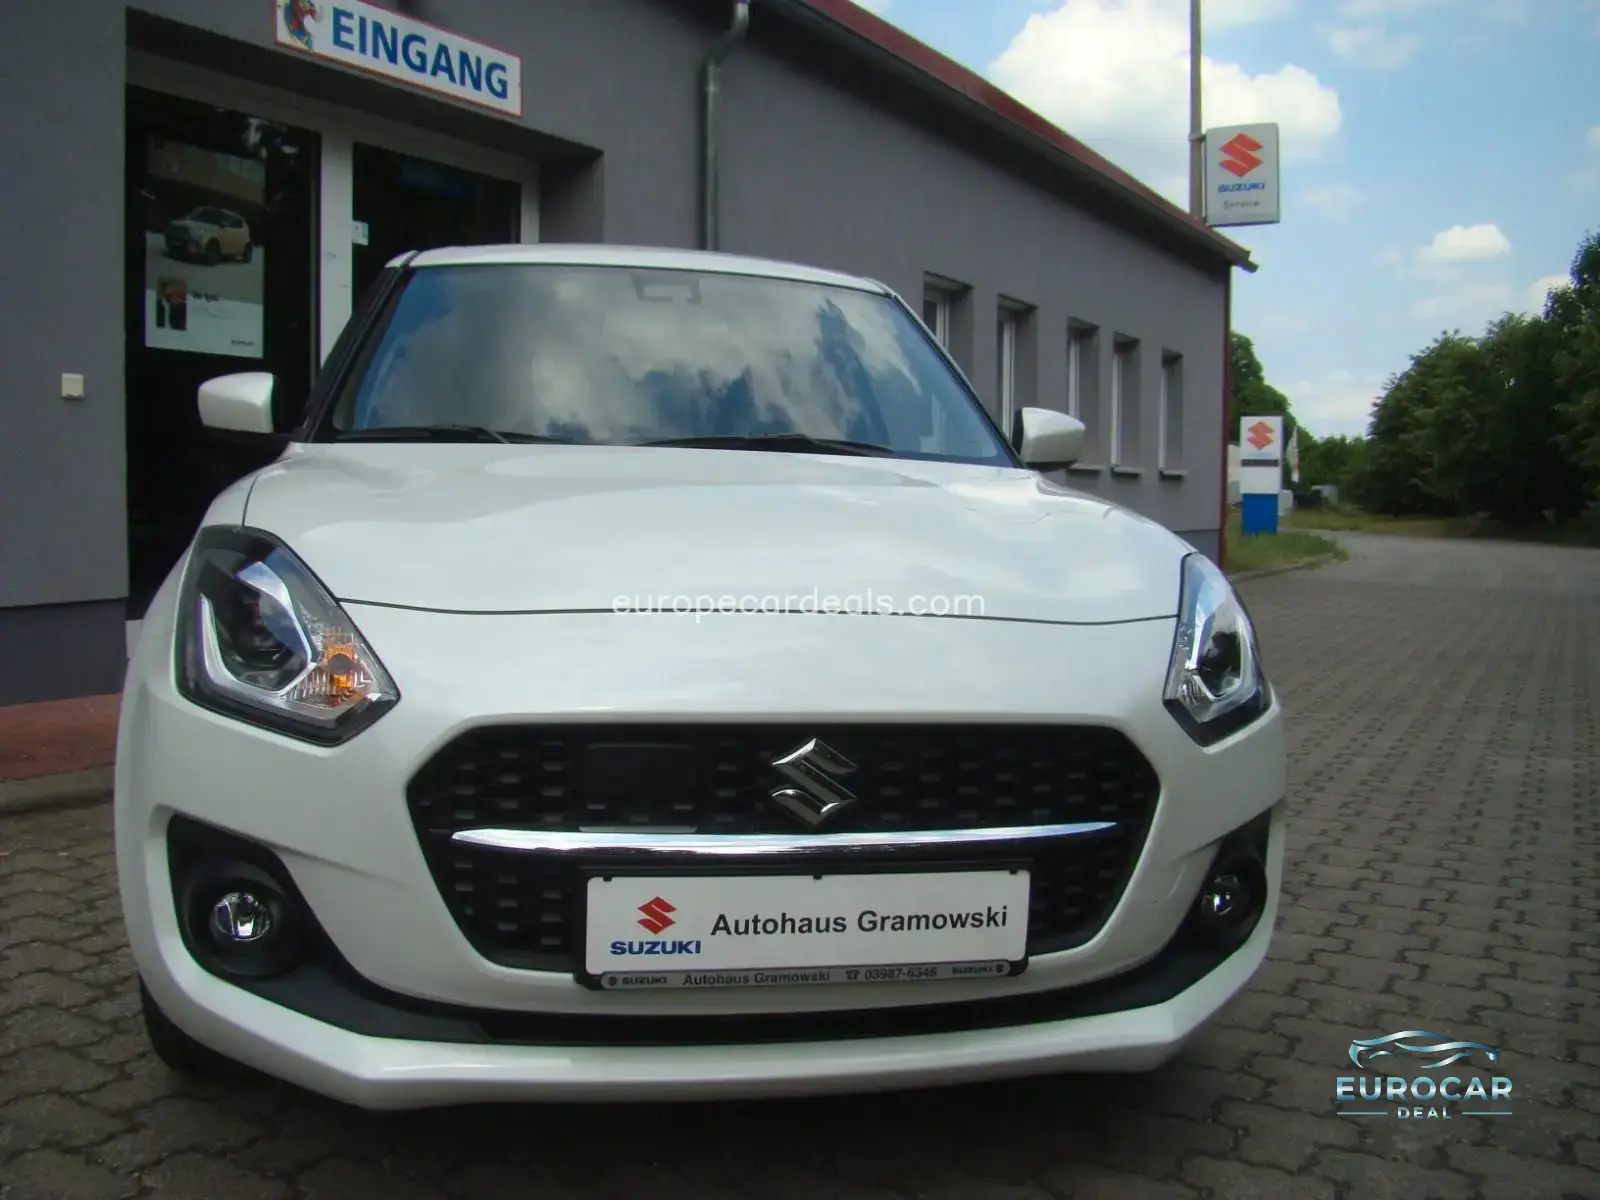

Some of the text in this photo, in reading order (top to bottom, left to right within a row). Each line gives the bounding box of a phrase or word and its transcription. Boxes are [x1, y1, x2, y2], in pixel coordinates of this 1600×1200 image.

[332, 6, 509, 100] EINGANG
[1218, 182, 1265, 194] SUZUKI
[710, 905, 1008, 937] Autohaus Gramowski
[609, 940, 702, 956] SUZUKI
[622, 976, 668, 986] SUZUKI
[682, 973, 750, 986] Autohaus
[754, 970, 830, 985] Gramowski
